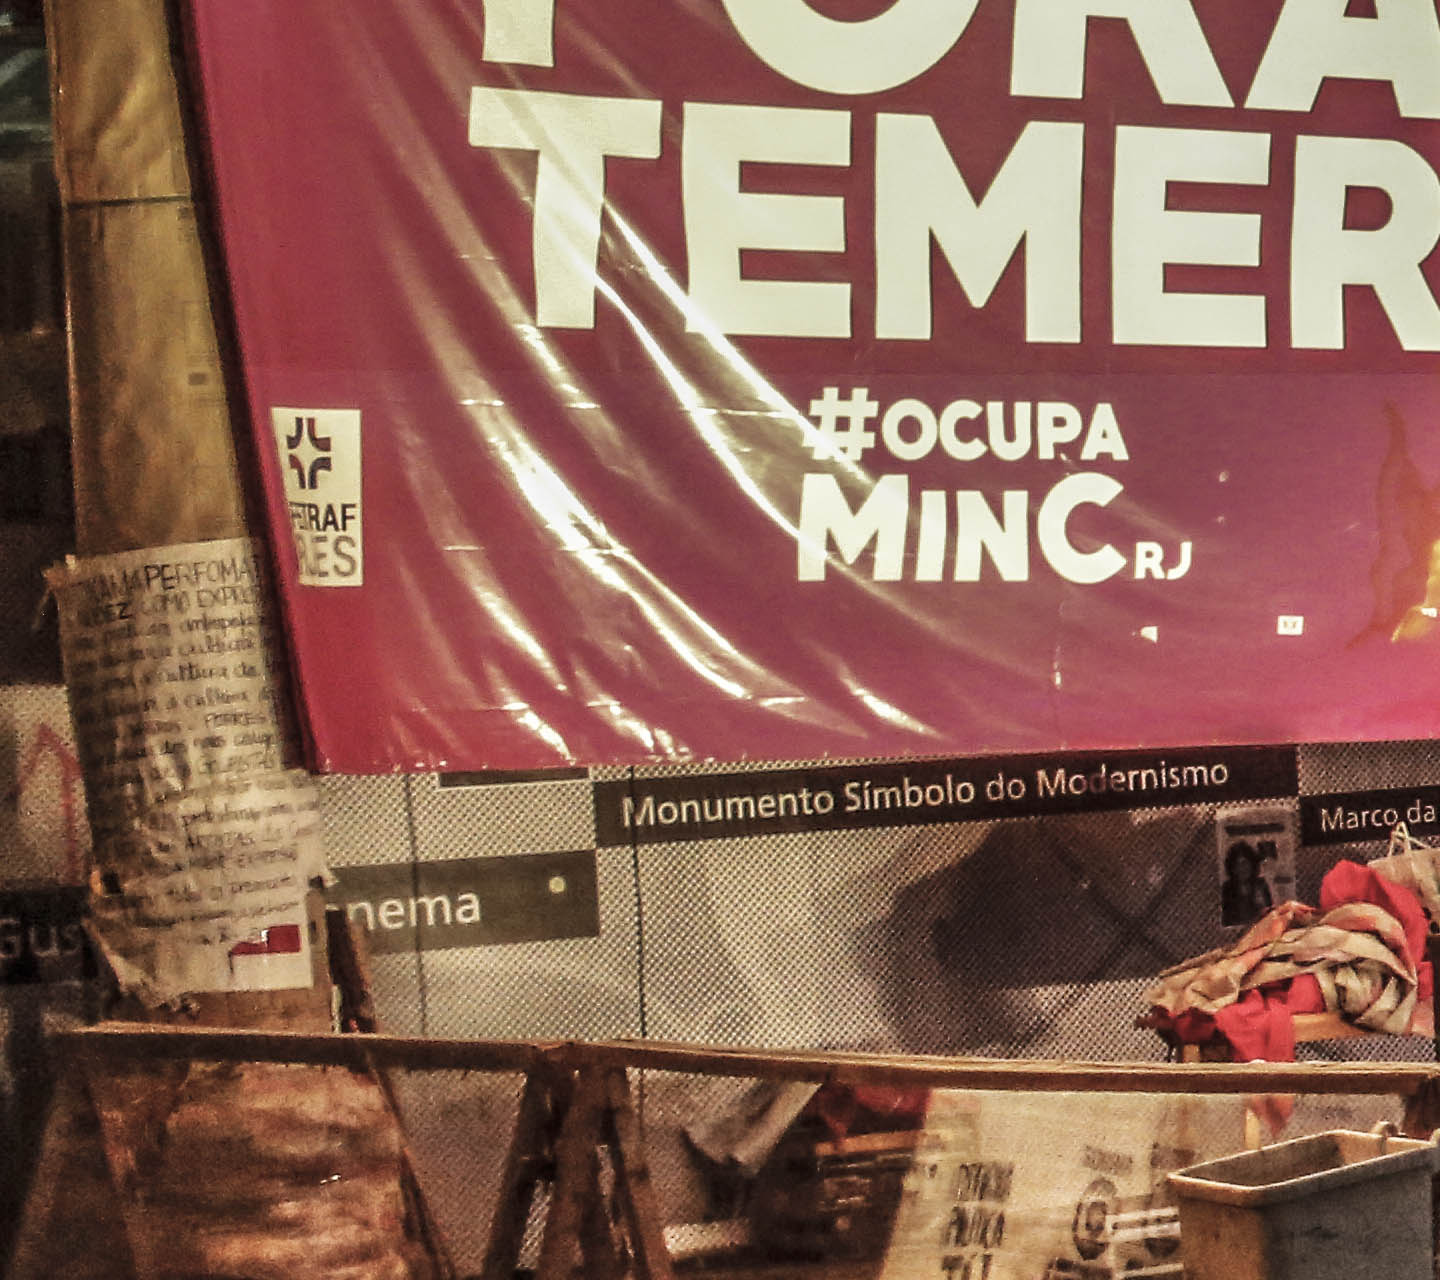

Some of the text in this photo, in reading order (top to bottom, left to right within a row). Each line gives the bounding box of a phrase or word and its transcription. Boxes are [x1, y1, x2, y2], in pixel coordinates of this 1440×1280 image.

[802, 387, 1129, 461] #OCUPA
[1134, 541, 1192, 580] RJ
[621, 761, 1229, 828] Monumento Símbolo do Modernismo
[1321, 807, 1399, 833] Marco
[1407, 799, 1437, 823] da
